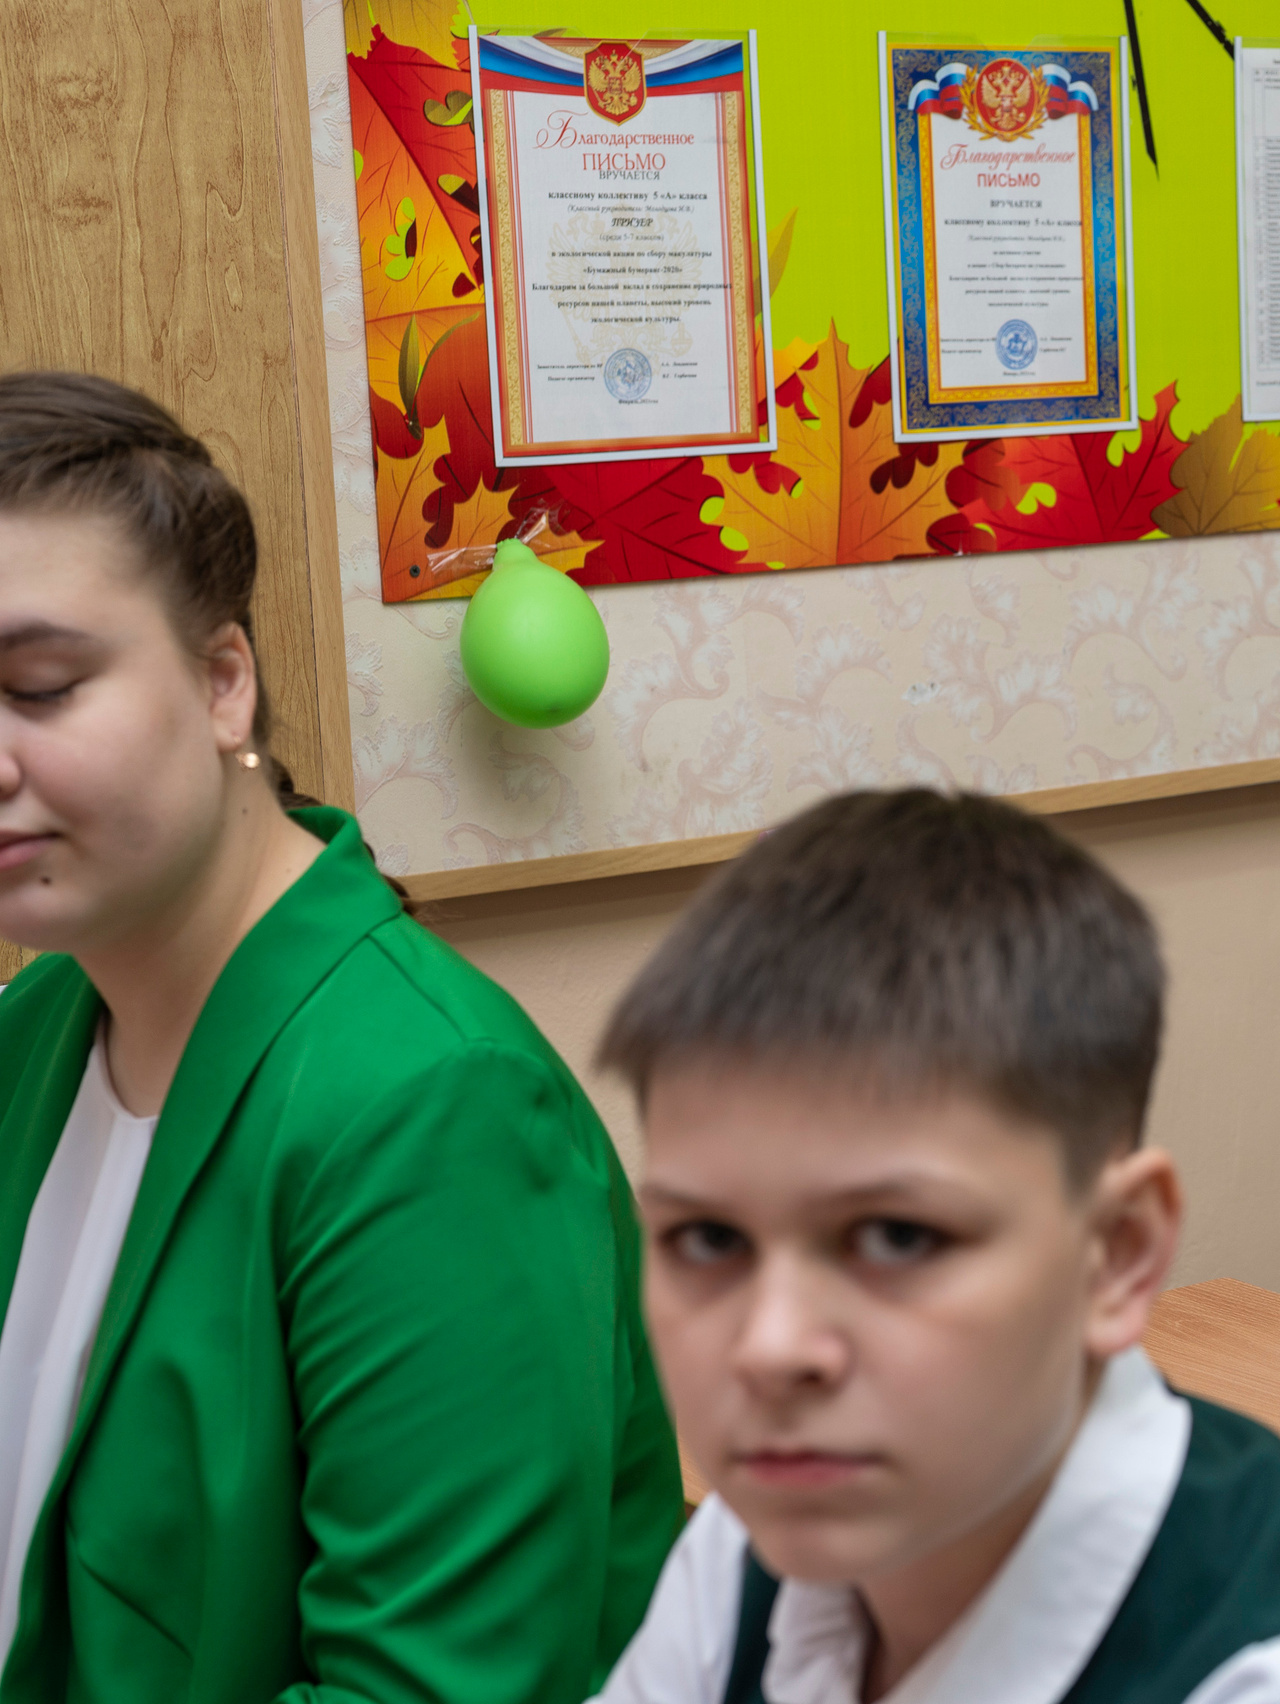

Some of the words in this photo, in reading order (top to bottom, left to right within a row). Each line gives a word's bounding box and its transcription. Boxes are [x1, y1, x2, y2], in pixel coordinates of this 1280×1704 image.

[532, 109, 695, 149] Благодарственное
[582, 152, 666, 171] ПИСЬМО
[940, 142, 1076, 171] Благодарственное
[599, 171, 660, 180] ВРУЧАЕТСЯ
[976, 173, 1041, 188] ПИСЬМО
[548, 192, 595, 201] классному
[598, 192, 648, 201] коллективу
[653, 191, 658, 200] 5
[679, 192, 708, 200] класса
[611, 217, 654, 227] ПРИЗЕР
